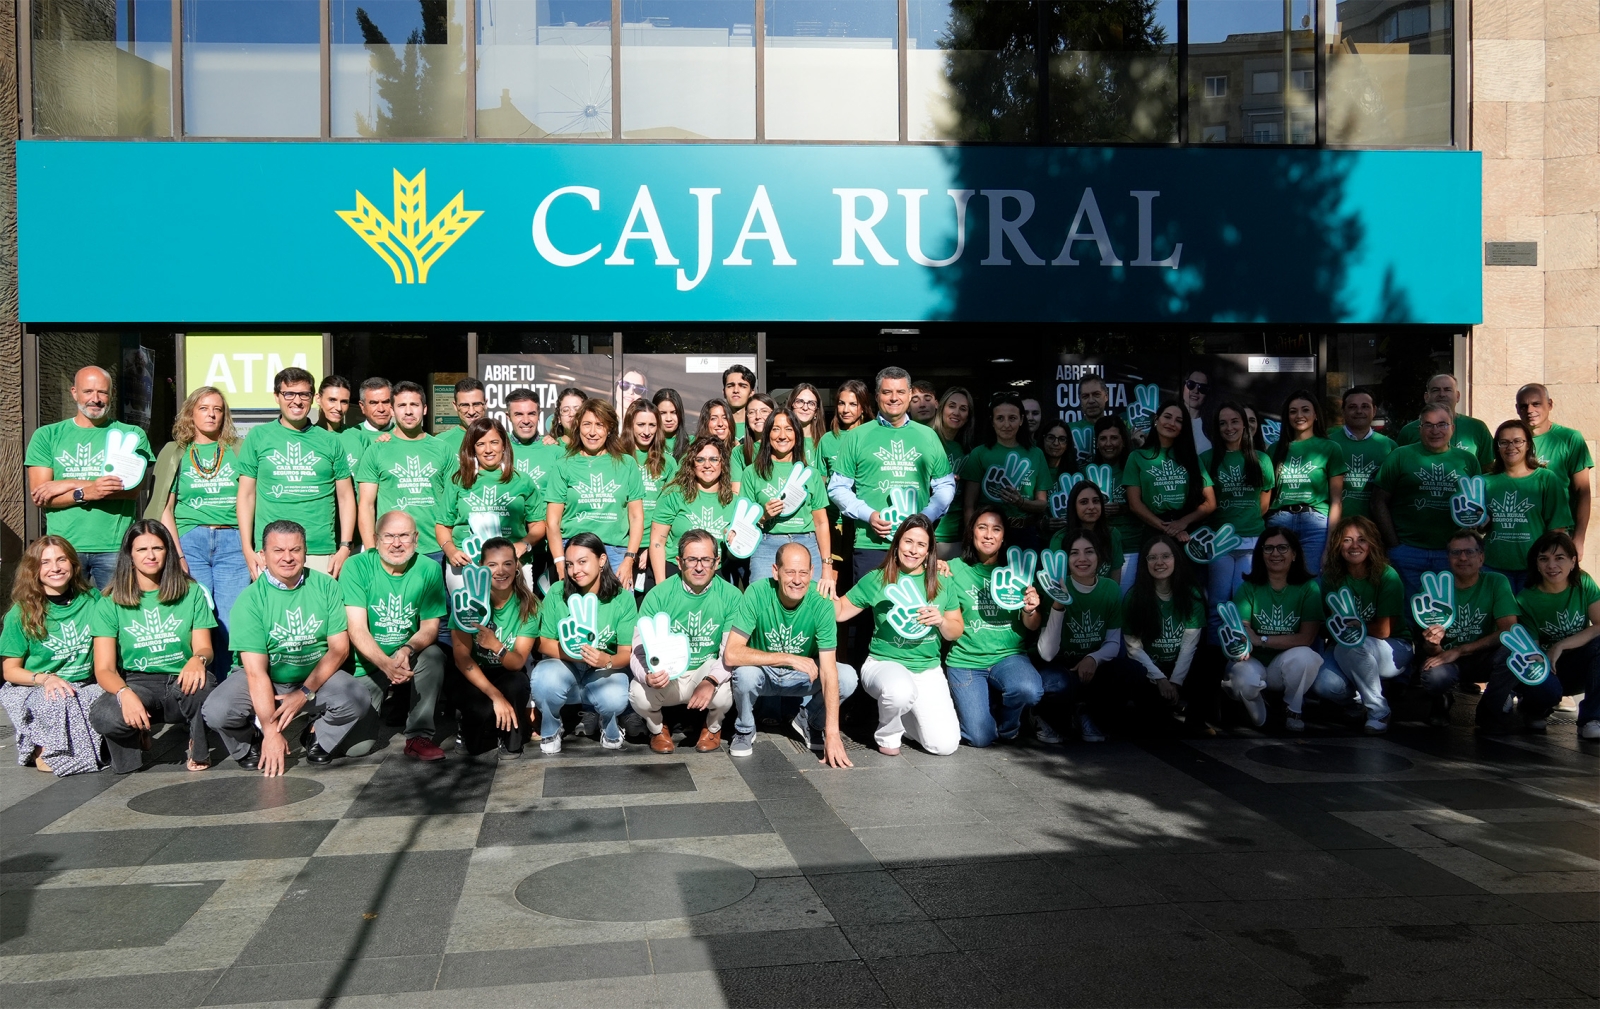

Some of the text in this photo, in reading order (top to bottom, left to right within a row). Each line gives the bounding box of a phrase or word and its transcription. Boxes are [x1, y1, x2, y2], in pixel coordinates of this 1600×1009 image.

[532, 184, 1183, 292] CAJA RURAL
[485, 365, 535, 381] ABRE TU
[1056, 364, 1088, 380] ABRE
[1056, 383, 1128, 408] CUTA
[133, 636, 180, 649] SEGUROS RGA
[154, 632, 176, 640] RURAL
